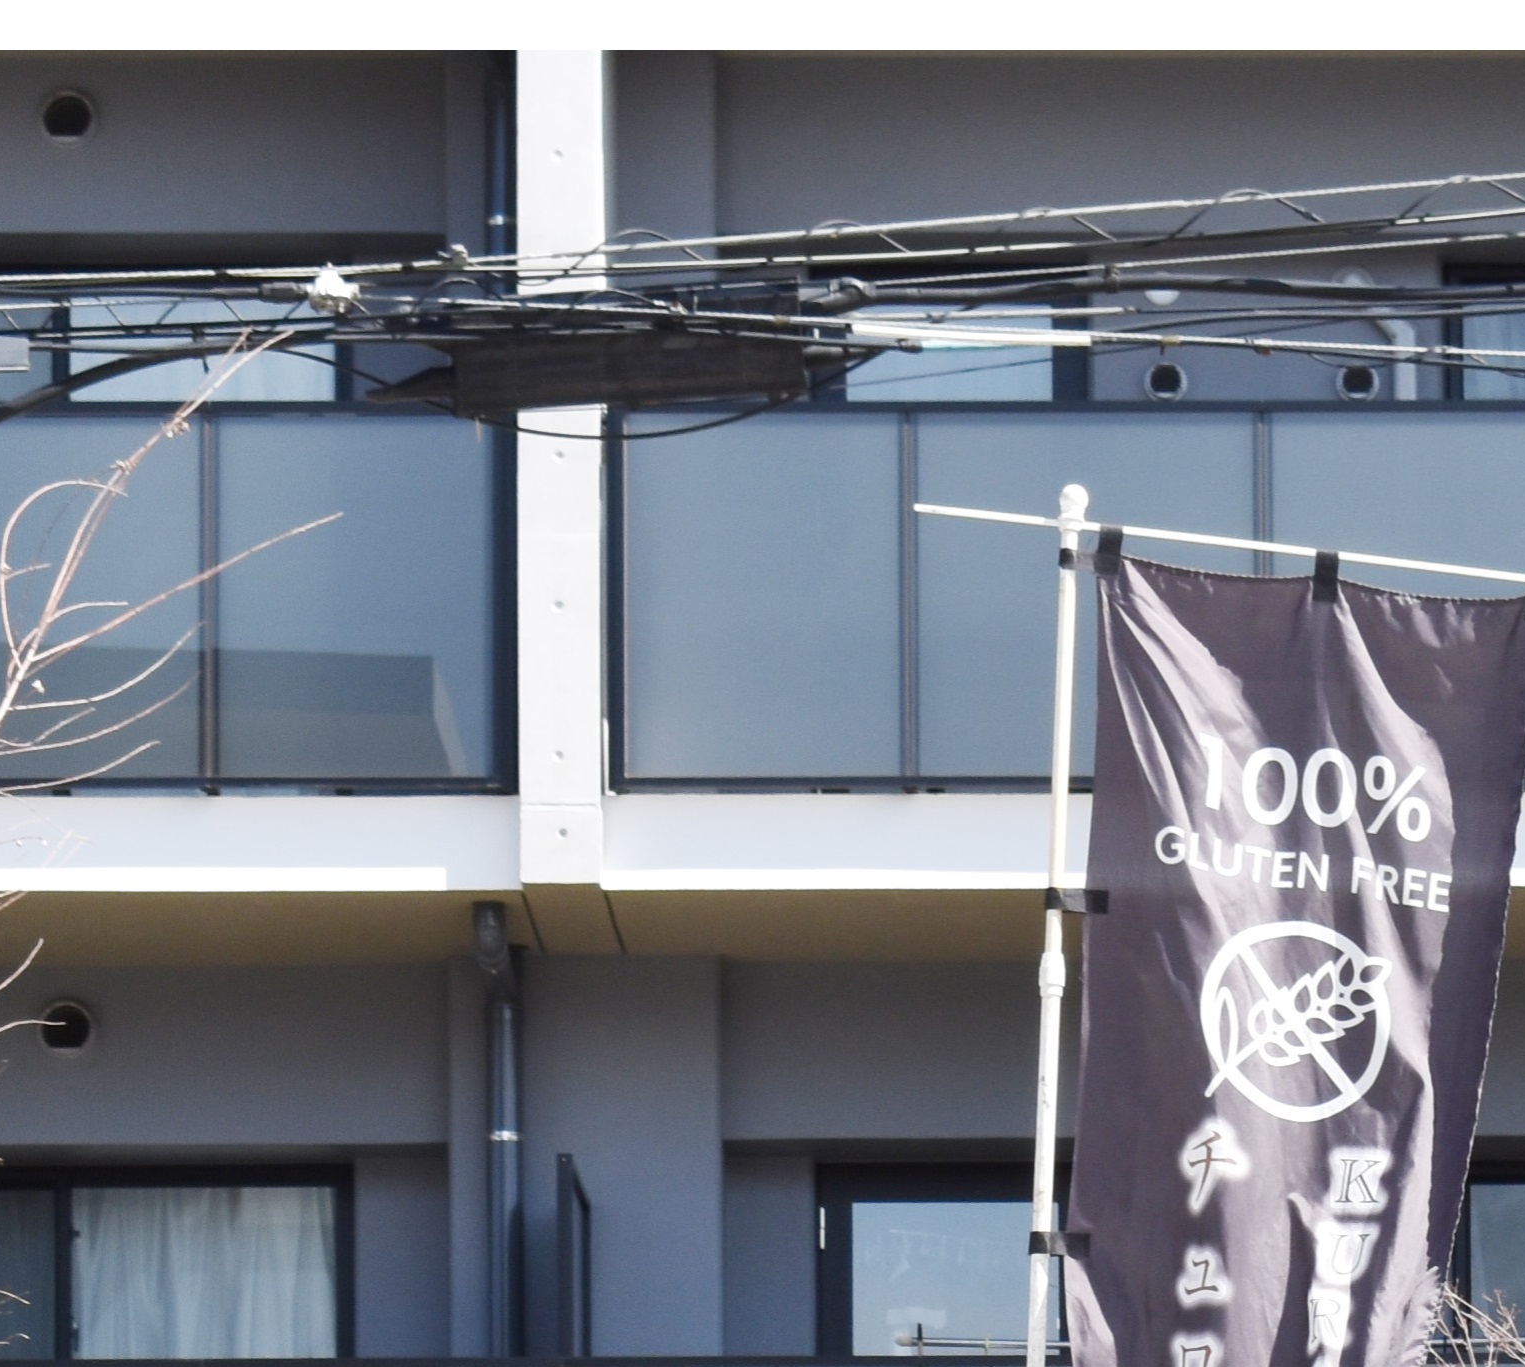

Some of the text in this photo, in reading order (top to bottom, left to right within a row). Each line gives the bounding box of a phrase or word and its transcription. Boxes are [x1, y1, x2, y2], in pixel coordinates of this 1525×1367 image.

[1199, 732, 1432, 842] 100%
[1154, 825, 1453, 913] GLUTEN FREE
